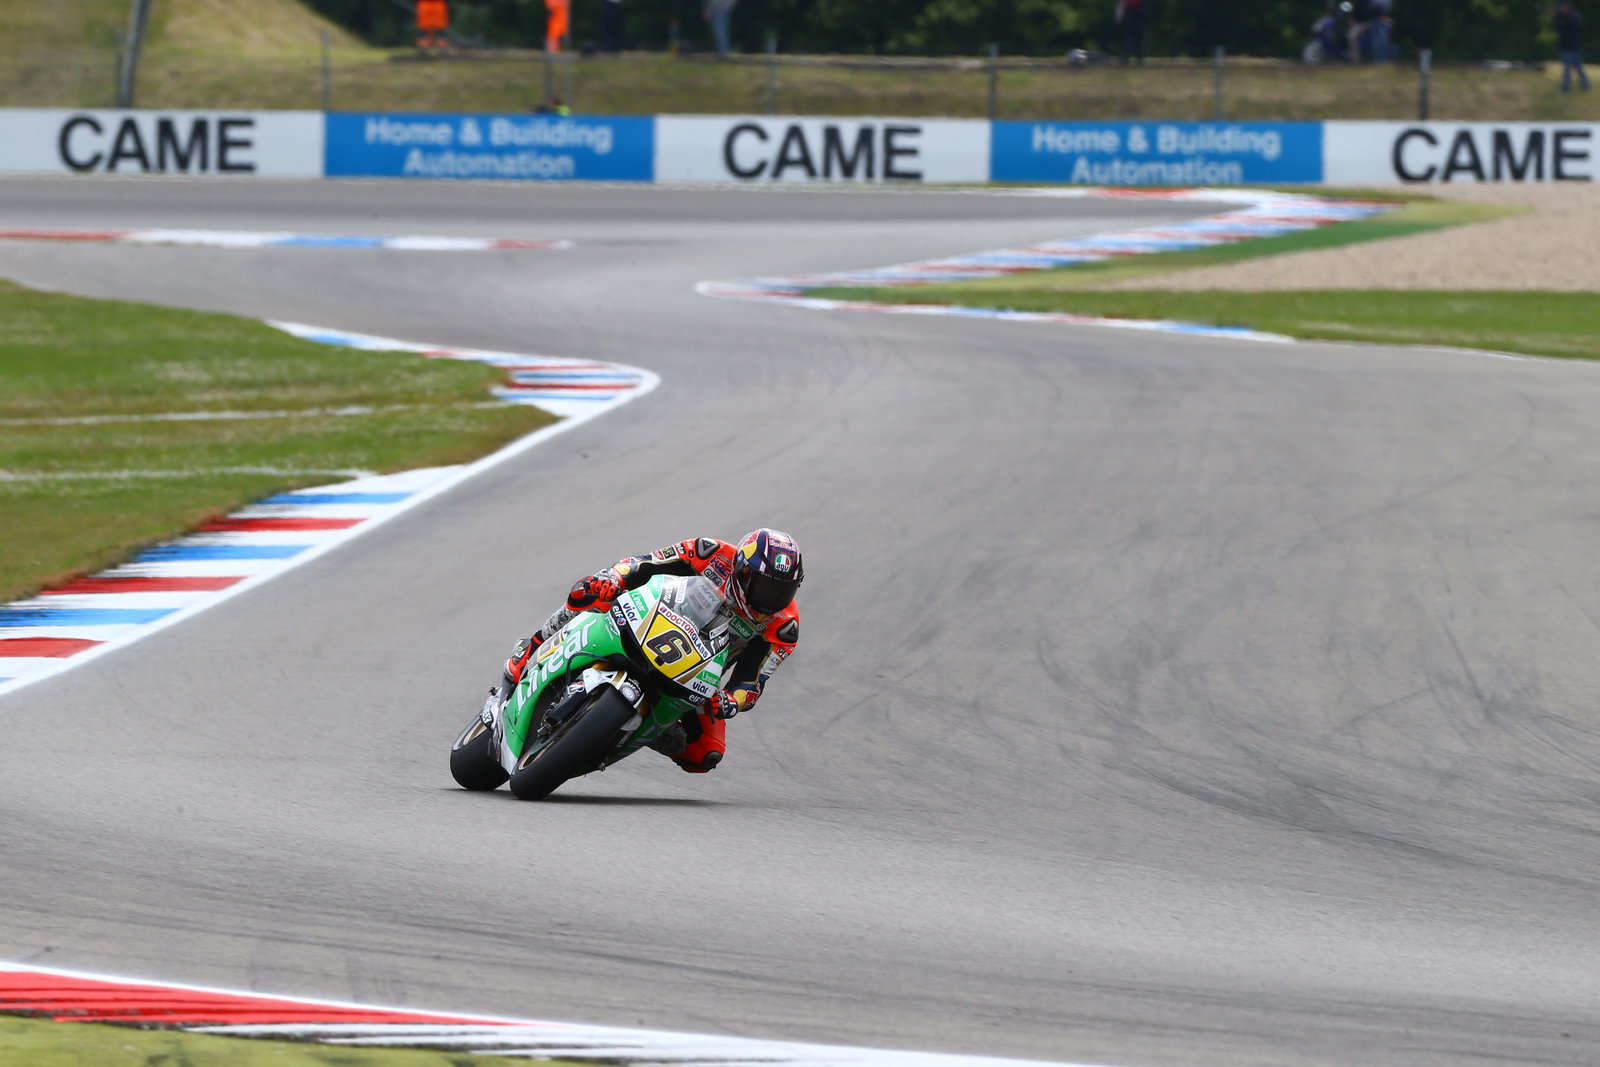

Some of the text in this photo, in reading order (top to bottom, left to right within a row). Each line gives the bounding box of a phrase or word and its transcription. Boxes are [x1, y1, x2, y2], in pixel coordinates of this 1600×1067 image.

[59, 116, 255, 172] CAME
[365, 118, 612, 153] Home & Building
[723, 124, 922, 180] CAME
[1032, 125, 1281, 160] Home & Building
[403, 149, 575, 177] Automation
[1071, 156, 1243, 183] Automation
[1392, 128, 1591, 183] CAME
[622, 602, 638, 622] viar
[730, 617, 751, 637] Linear
[645, 628, 693, 667] 6
[664, 610, 710, 659] DOCTORGLASS
[516, 617, 598, 715] Linear
[692, 681, 709, 694] viar
